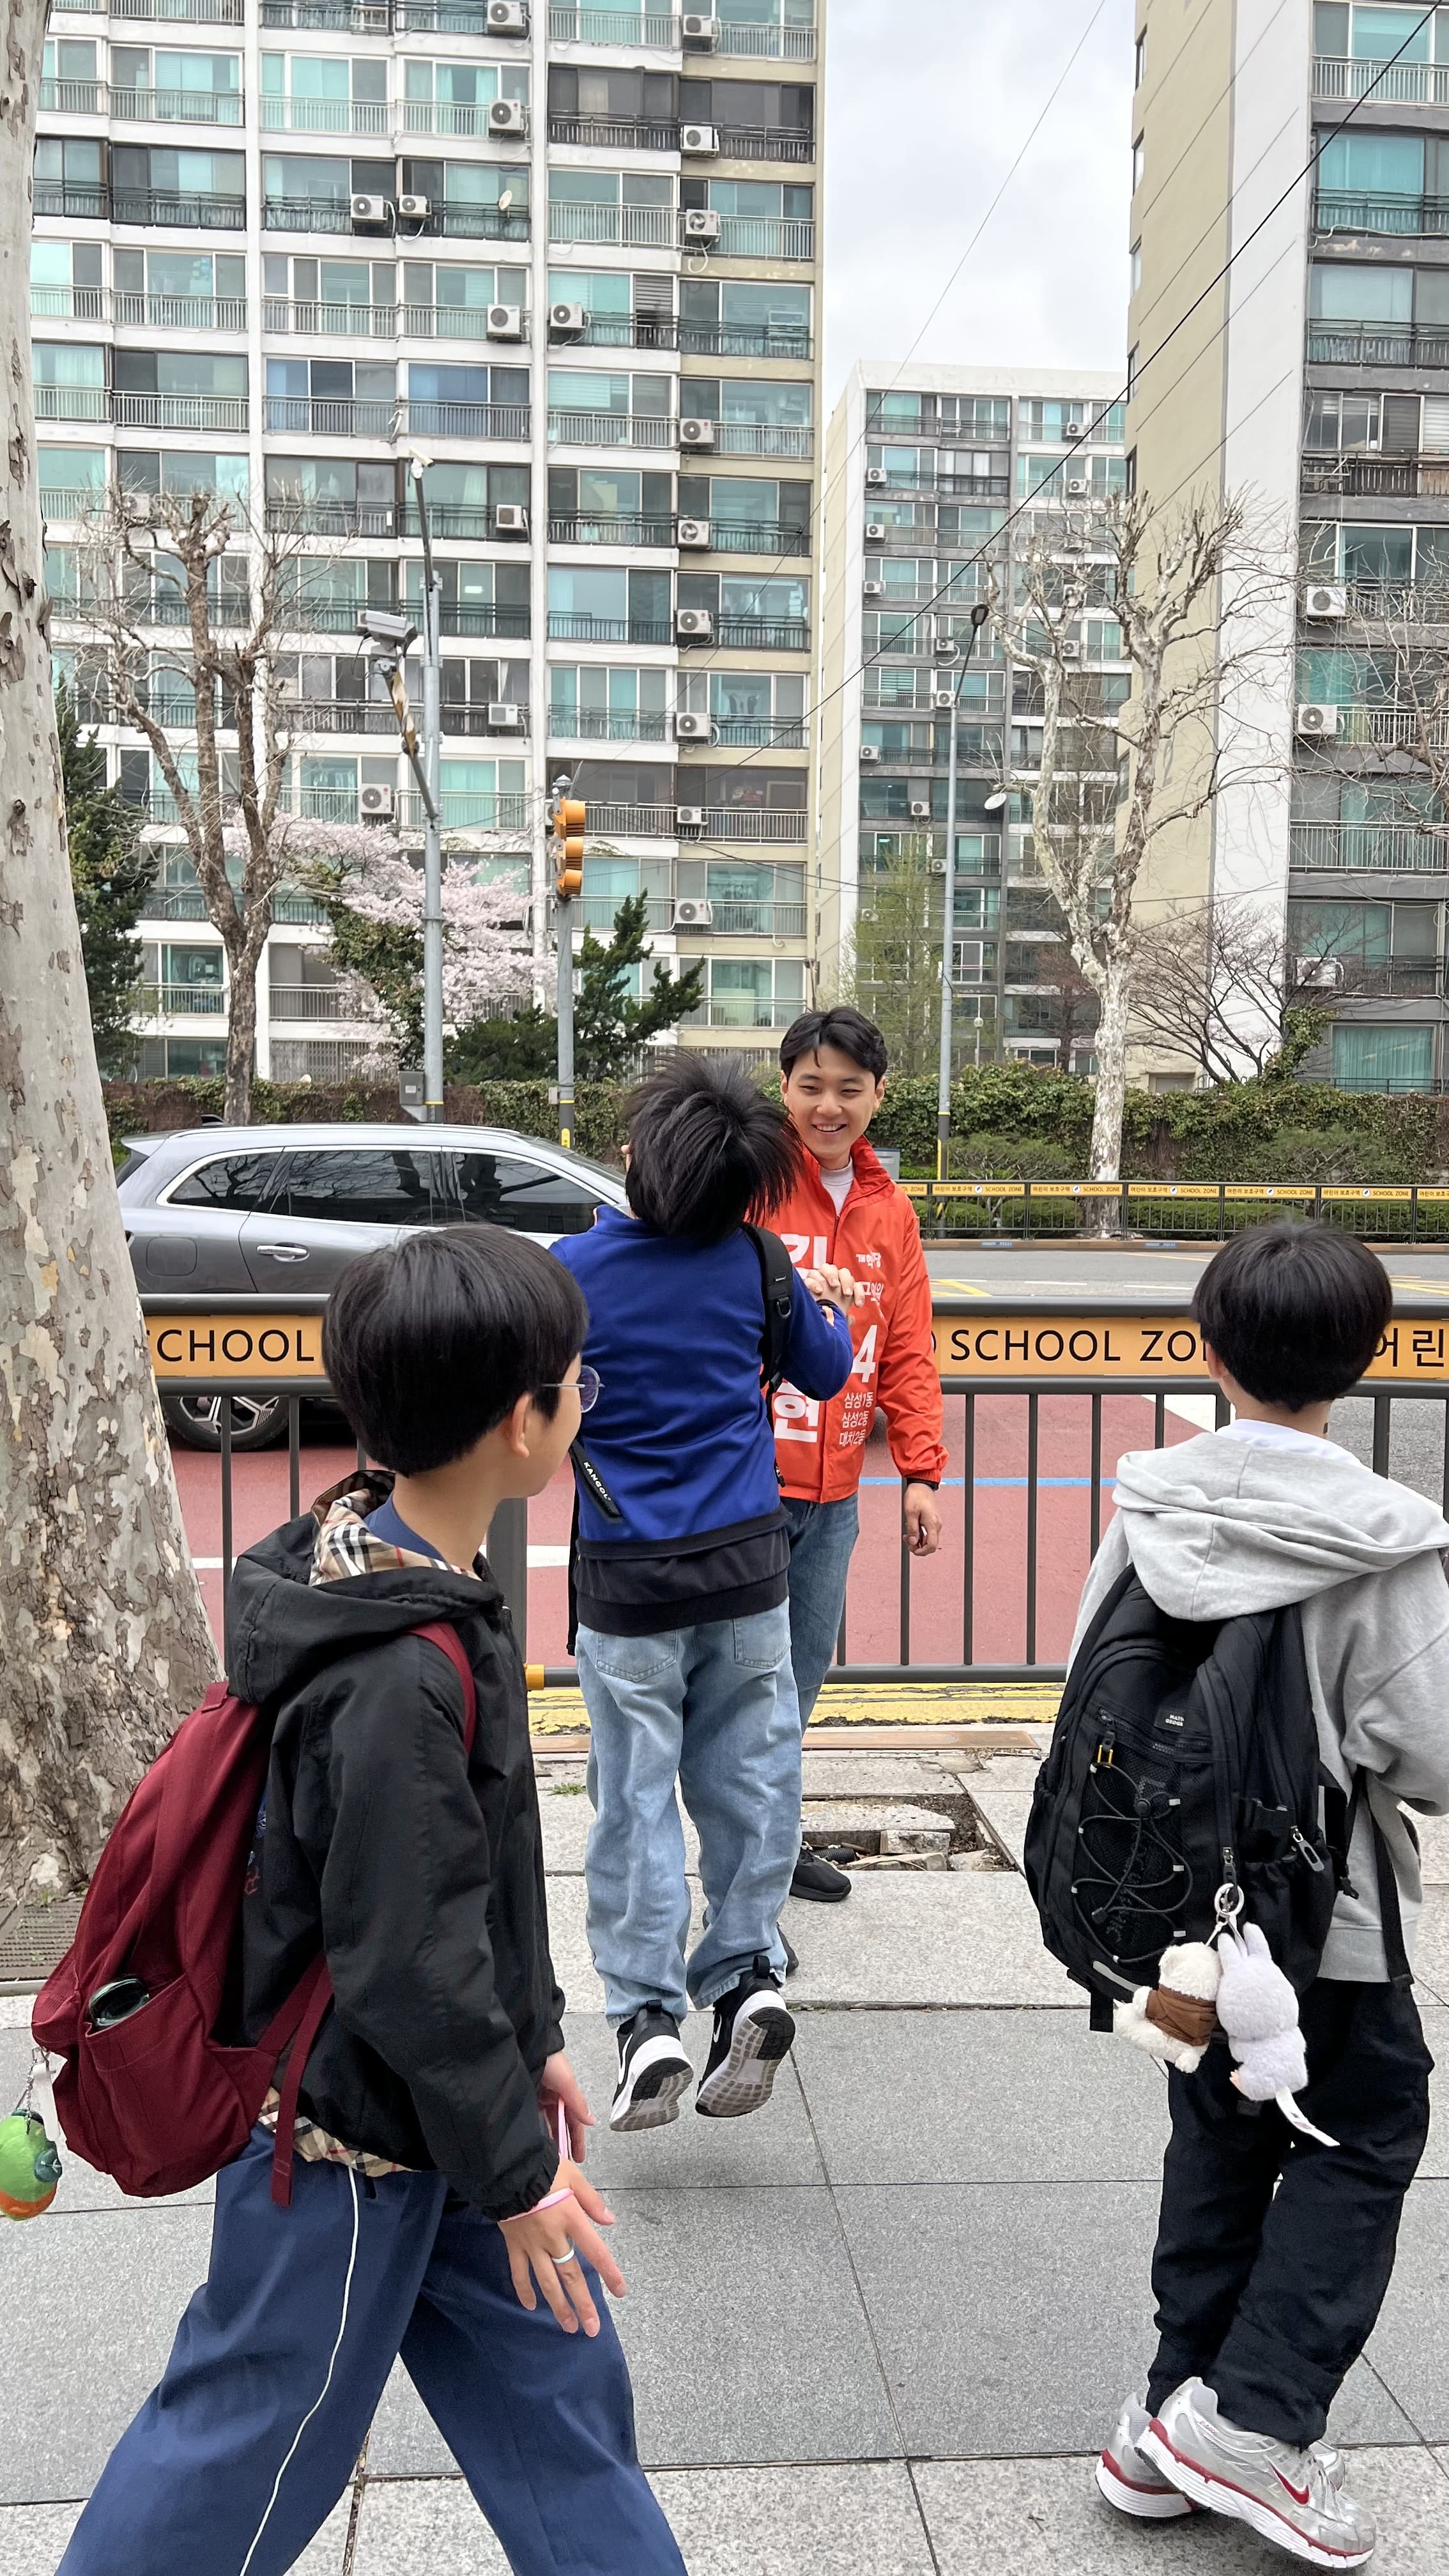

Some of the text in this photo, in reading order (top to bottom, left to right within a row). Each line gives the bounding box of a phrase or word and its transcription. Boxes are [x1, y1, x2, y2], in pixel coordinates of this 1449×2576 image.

[147, 1330, 314, 1361] CHOOL
[951, 1330, 1208, 1361] SCHOOL ZO
[844, 1392, 874, 1409] 삼성1동
[841, 1410, 870, 1429] 삼성2동
[838, 1429, 866, 1447] 대치2동
